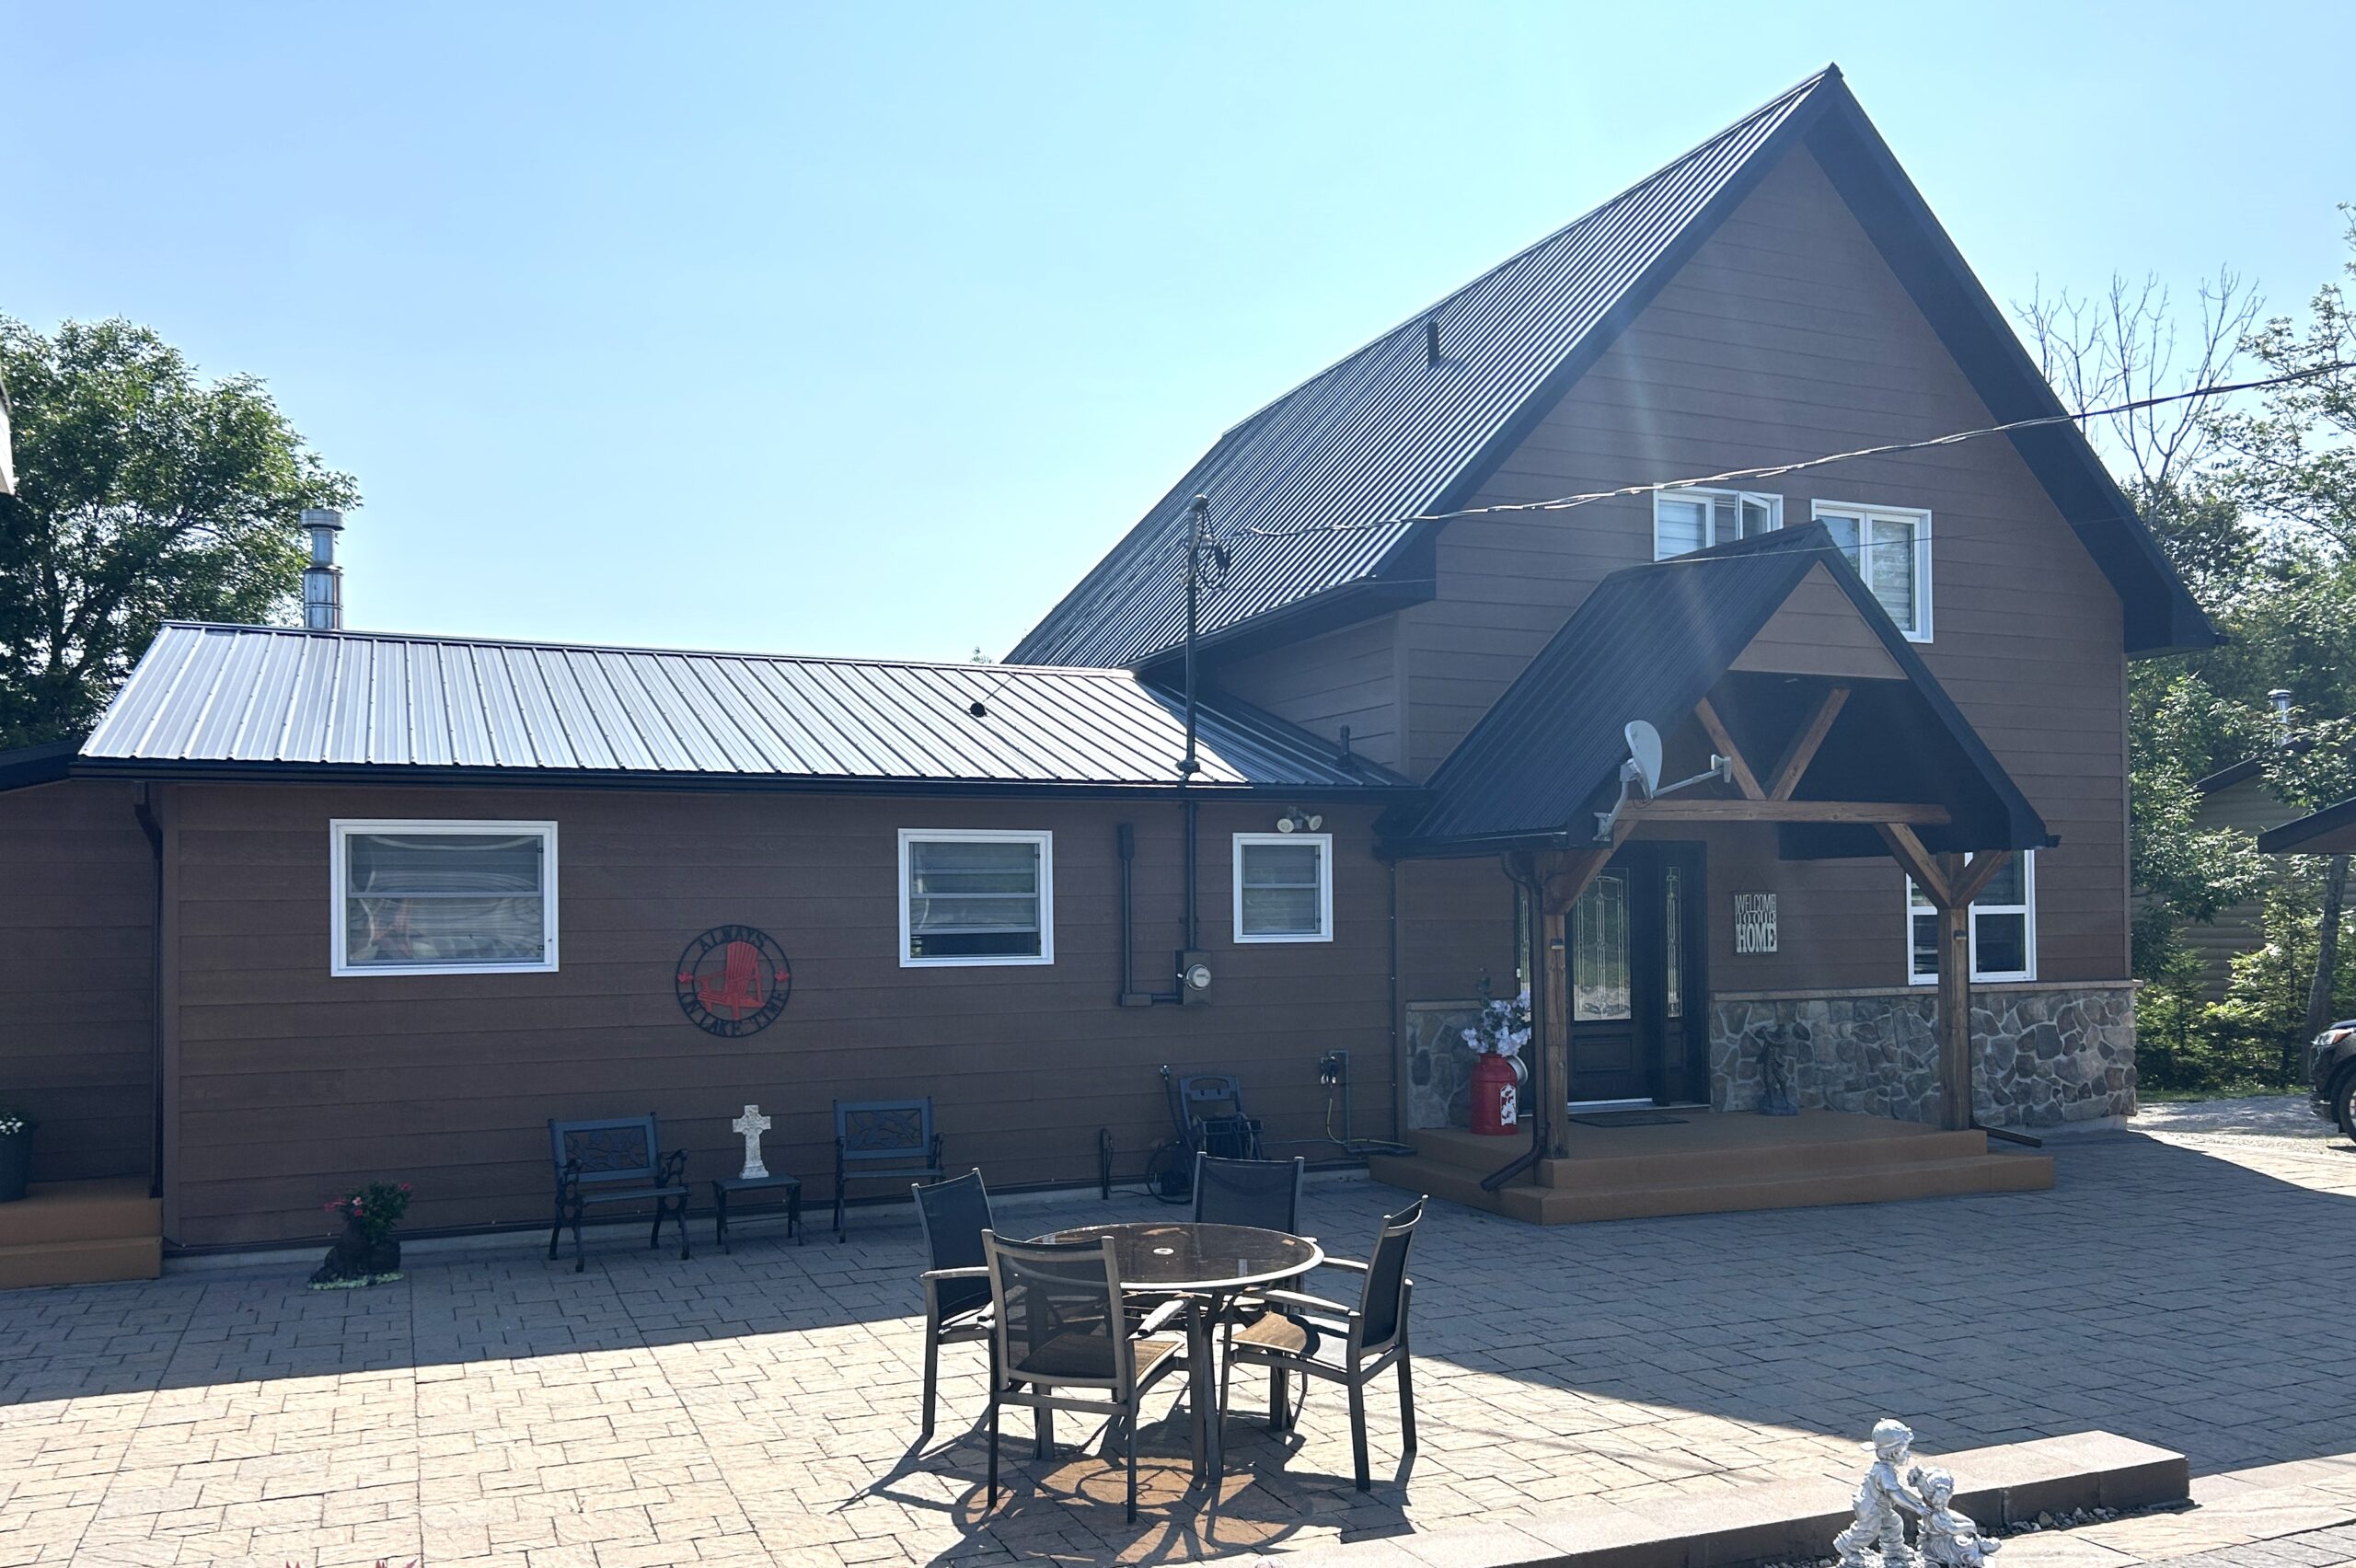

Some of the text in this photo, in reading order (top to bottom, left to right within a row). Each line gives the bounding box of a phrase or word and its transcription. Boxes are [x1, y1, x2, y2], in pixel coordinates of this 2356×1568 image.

[1735, 894, 1776, 913] WELCOME
[1736, 911, 1776, 924] TO OUR
[700, 927, 765, 951] ALWAYS
[1736, 923, 1777, 952] HOME
[699, 1013, 745, 1036] LAKE
[751, 992, 789, 1029] TIME
